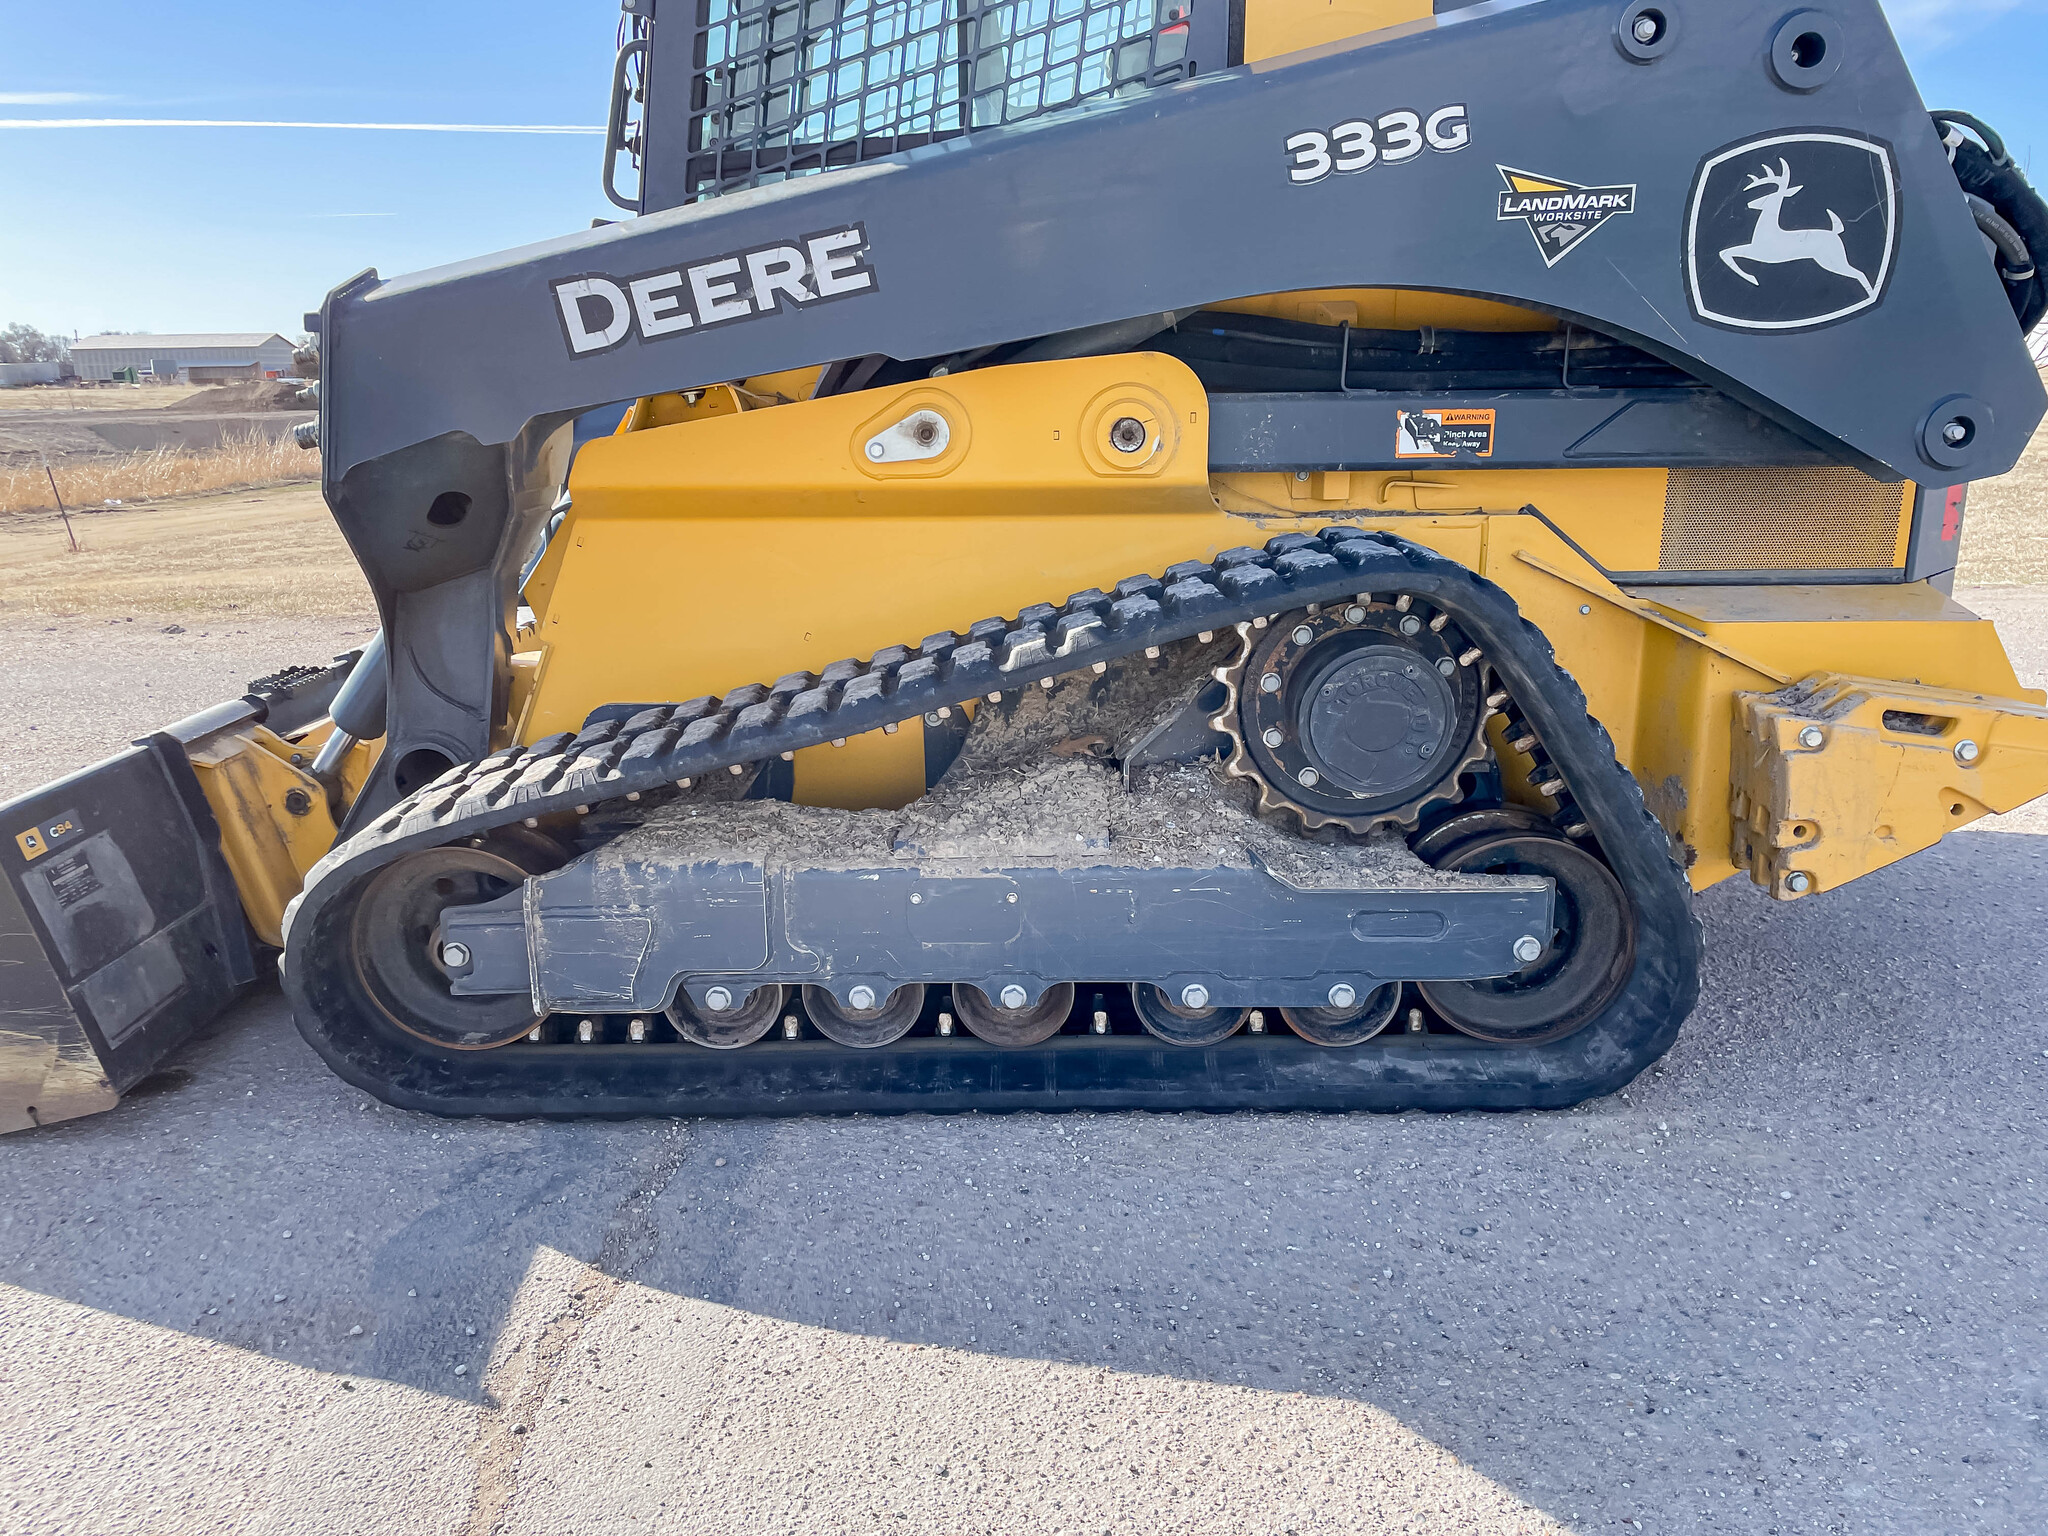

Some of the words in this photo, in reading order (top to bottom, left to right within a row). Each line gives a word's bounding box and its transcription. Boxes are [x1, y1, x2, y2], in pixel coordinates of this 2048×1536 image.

[1285, 104, 1470, 182] 333G
[1533, 210, 1603, 222] WORKSITE
[555, 229, 871, 353] DEERE
[1468, 430, 1487, 438] Area
[1462, 440, 1481, 449] Away
[49, 820, 73, 838] C84
